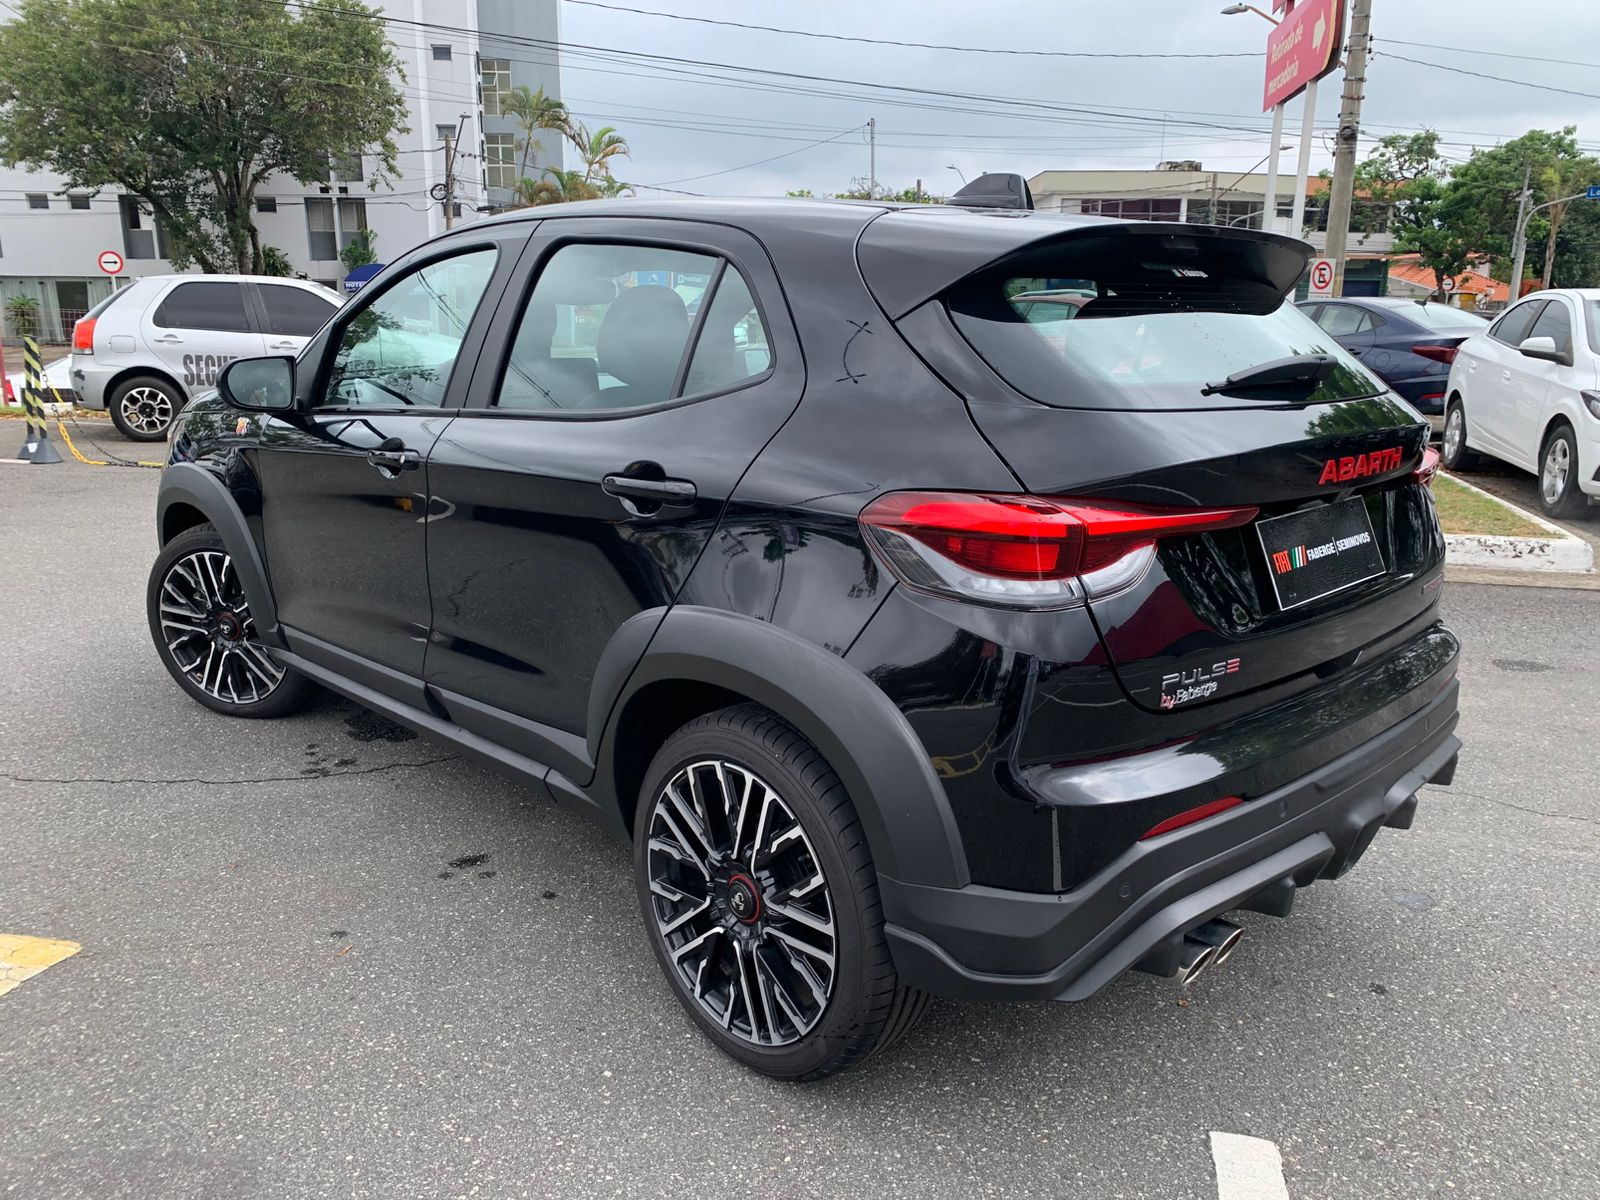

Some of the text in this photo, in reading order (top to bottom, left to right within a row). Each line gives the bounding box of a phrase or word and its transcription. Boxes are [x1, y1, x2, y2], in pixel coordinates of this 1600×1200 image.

[1318, 446, 1403, 485] ABARTH
[1272, 531, 1371, 575] FIAT FABERGE SEMINOVOS
[1162, 657, 1241, 690] PULSE
